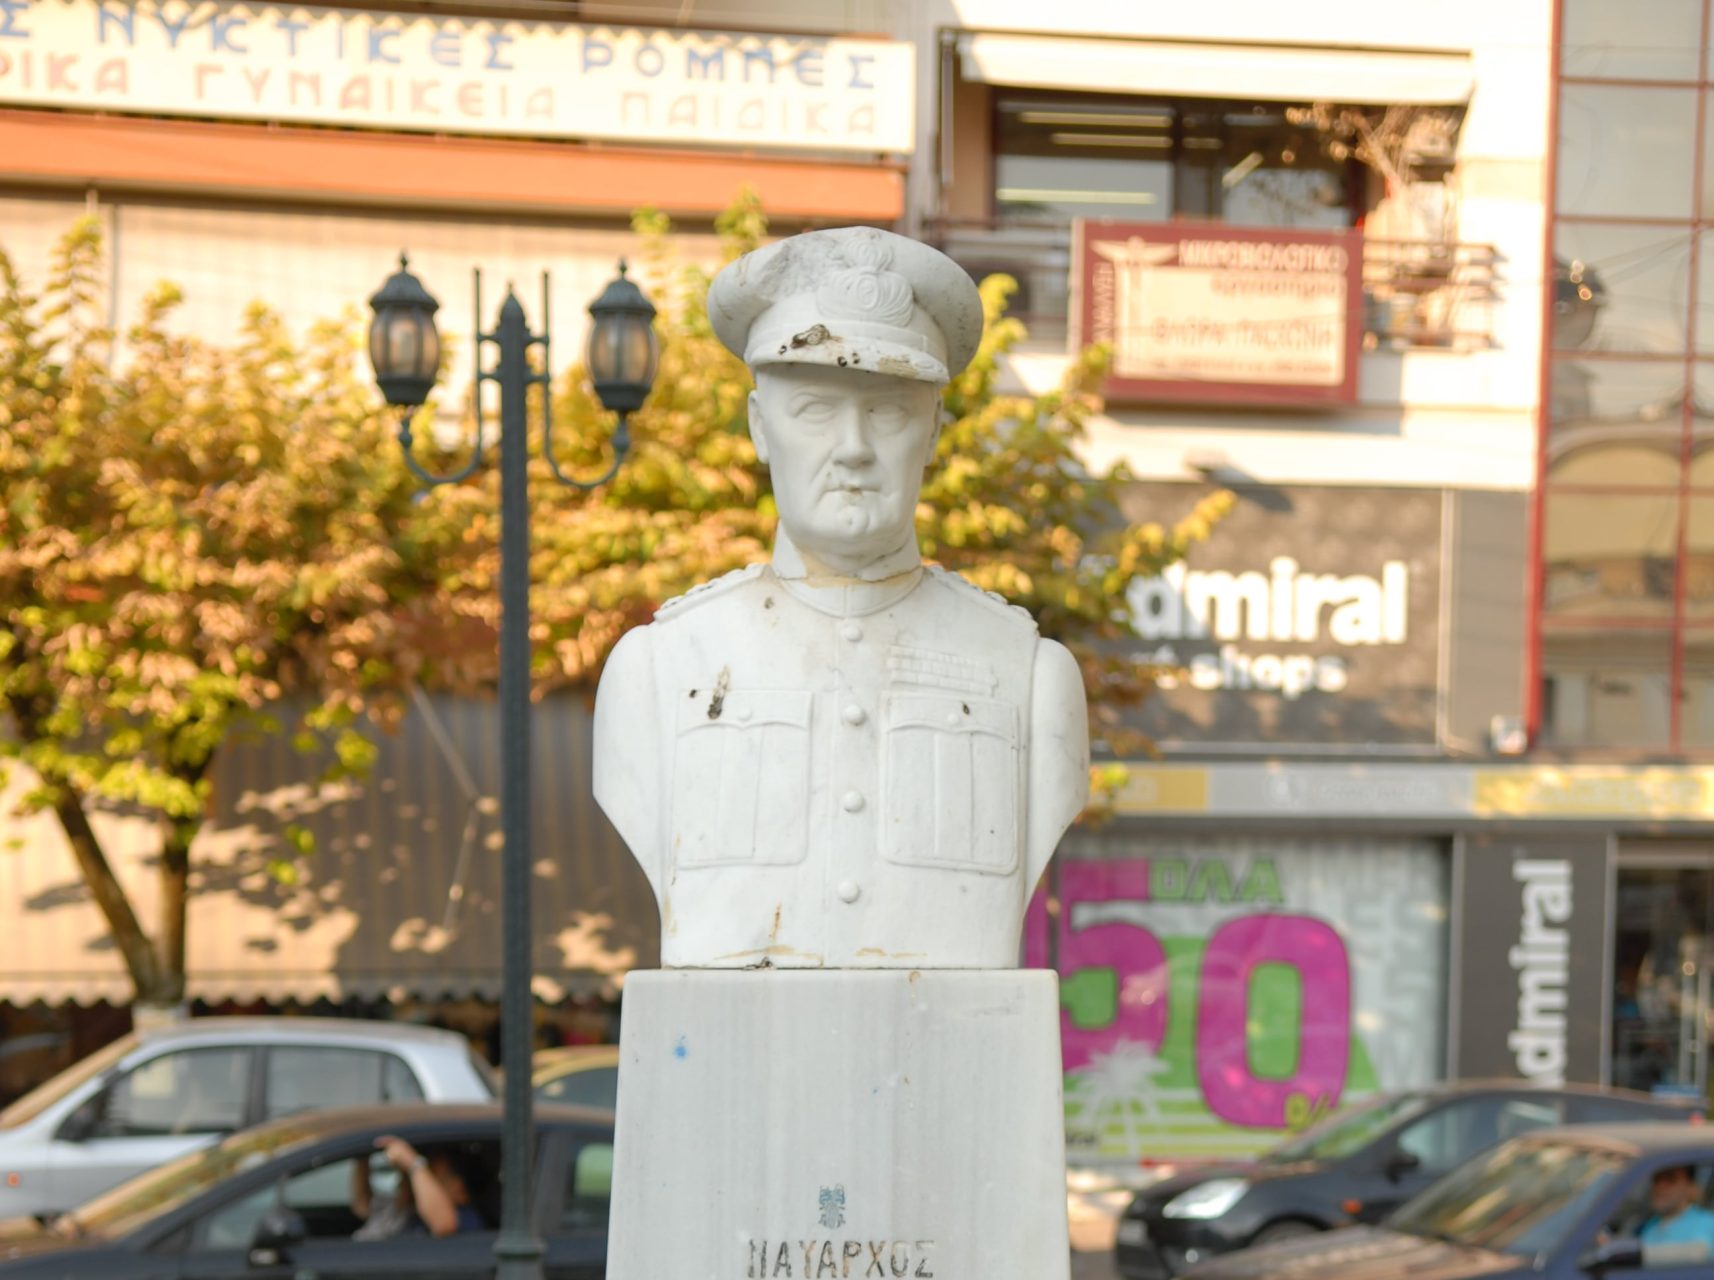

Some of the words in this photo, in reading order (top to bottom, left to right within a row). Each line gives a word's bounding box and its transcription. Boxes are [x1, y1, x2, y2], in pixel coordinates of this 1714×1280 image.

[97, 2, 515, 69] ΝΥΚΤΙΚΕΣ
[580, 40, 875, 89] ΡΟΜΠΕΣ
[195, 64, 554, 119] ΓΥΝΑΙΚΕΙΑ
[619, 91, 875, 134] ΠΑΙΔΙΚΑ
[1086, 556, 1408, 646] dmiral
[1190, 644, 1348, 700] shops
[747, 1239, 936, 1279] ΝΑΥΑΡΧΟΣ
